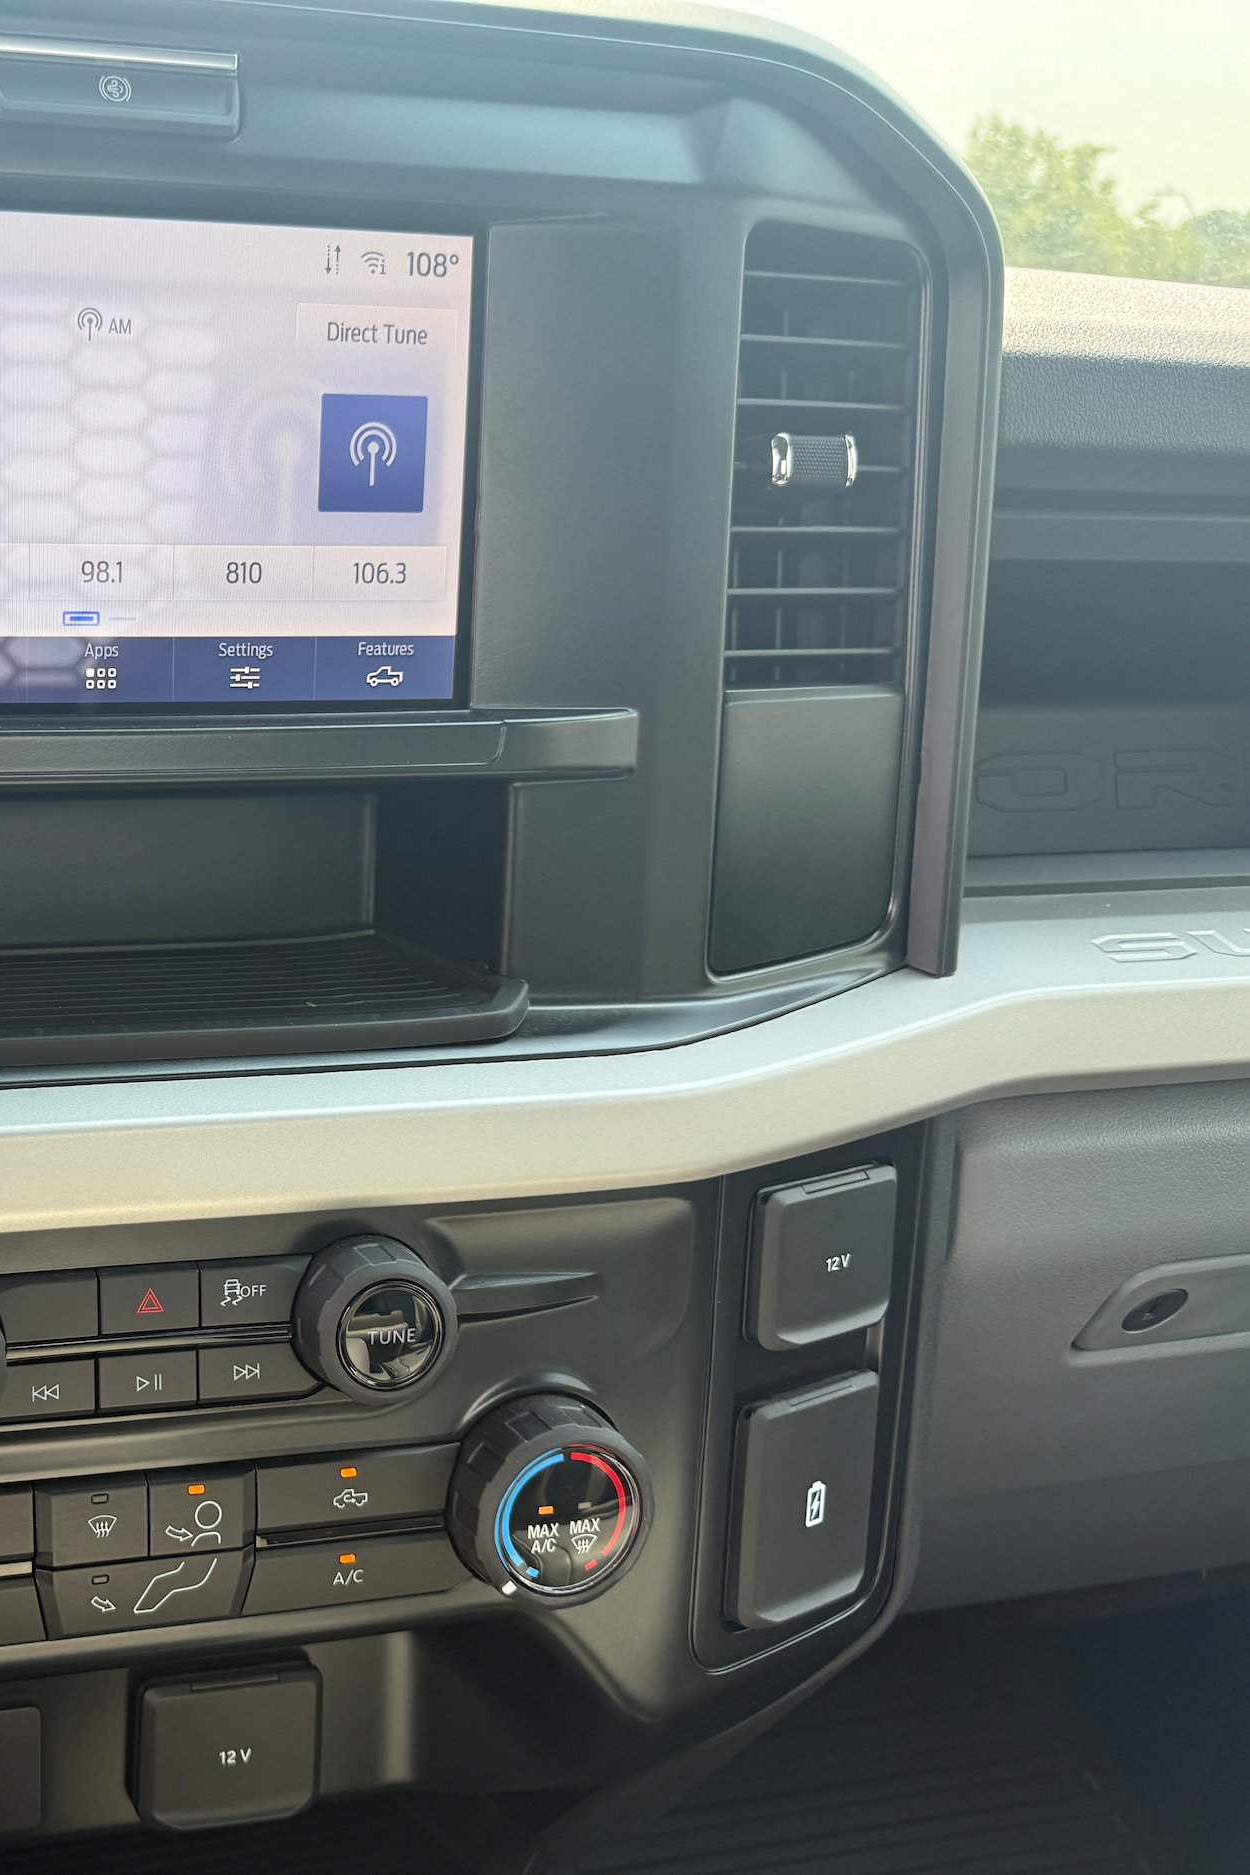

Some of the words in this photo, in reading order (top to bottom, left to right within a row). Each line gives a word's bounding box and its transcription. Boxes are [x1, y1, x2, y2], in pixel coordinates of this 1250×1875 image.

[406, 250, 459, 277] 108°
[108, 316, 132, 335] AM
[326, 321, 378, 344] Direct
[383, 323, 428, 345] Tune
[81, 561, 124, 584] 98.1
[226, 562, 263, 584] 810
[352, 563, 408, 586] 106.3
[84, 642, 120, 661] Apps
[218, 641, 273, 660] Settings
[357, 641, 414, 657] Features
[242, 1283, 267, 1299] OFF
[367, 1327, 417, 1346] TUNE
[527, 1522, 560, 1539] MAX
[569, 1517, 600, 1535] MAX
[531, 1538, 557, 1554] A/C
[333, 1568, 365, 1587] A/C
